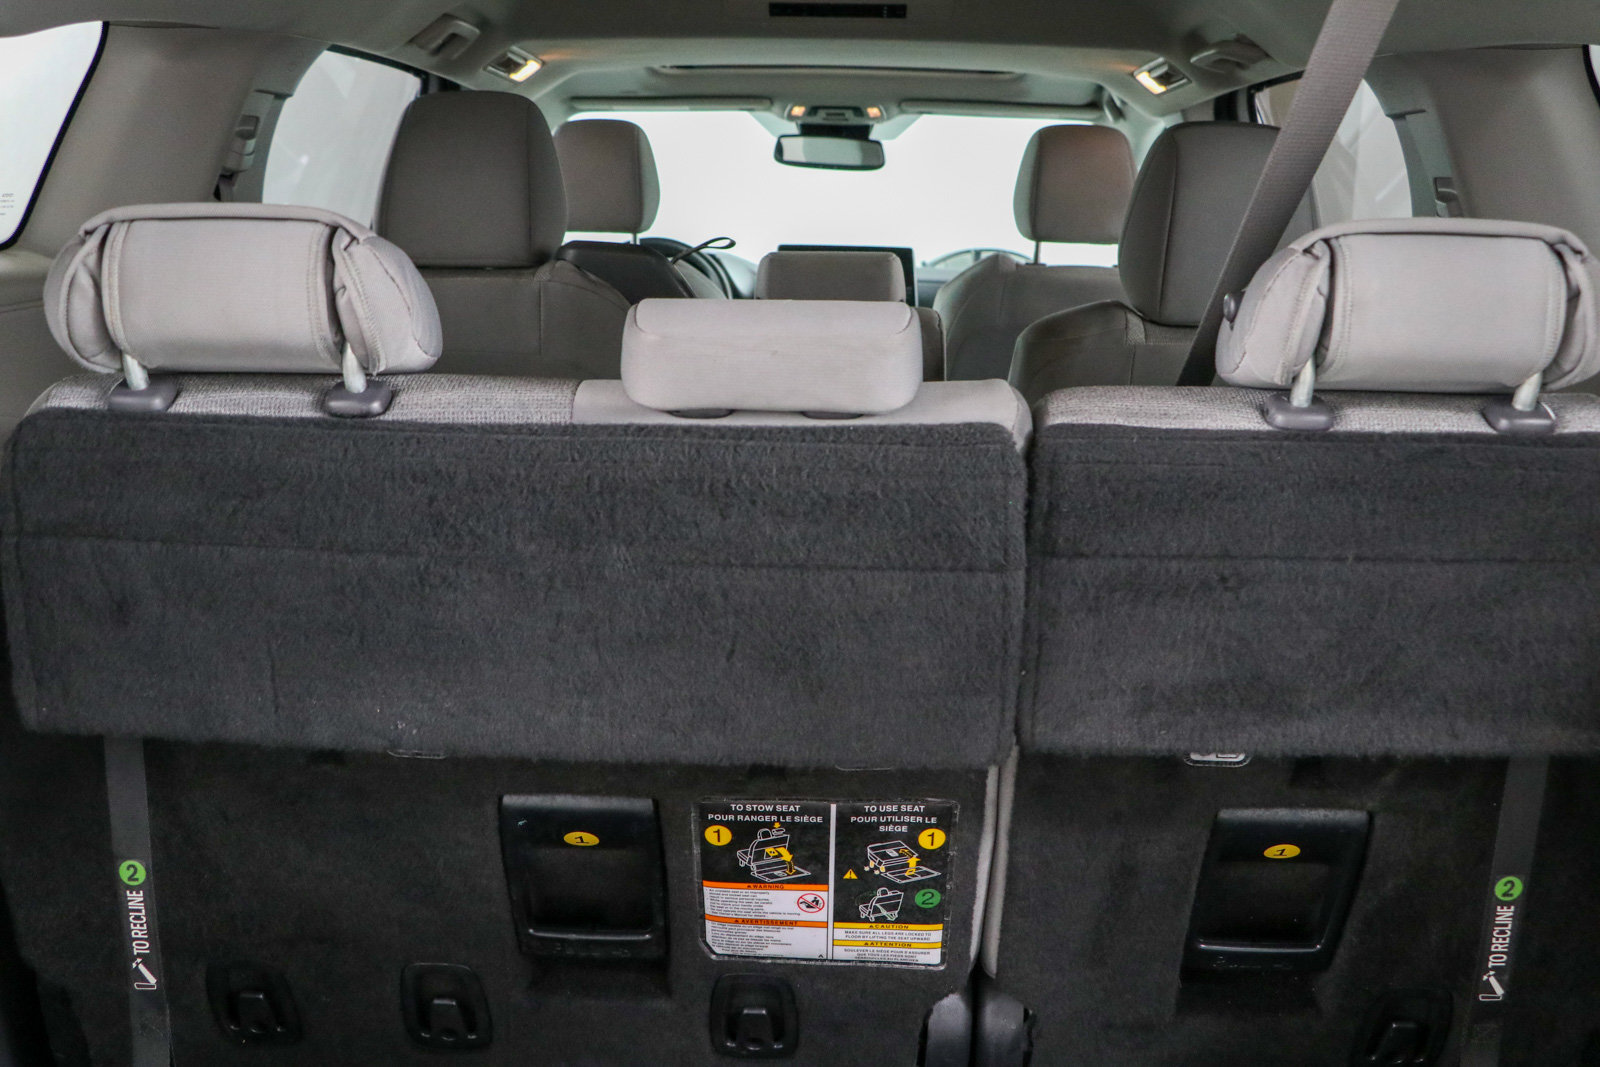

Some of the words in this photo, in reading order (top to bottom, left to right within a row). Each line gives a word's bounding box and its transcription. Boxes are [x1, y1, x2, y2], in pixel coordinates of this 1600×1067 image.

[745, 804, 774, 812] STOW
[776, 804, 801, 812] SEAT
[864, 805, 877, 813] TO
[900, 805, 925, 813] SEAT
[708, 813, 735, 821] POUR
[737, 814, 778, 822] RANGER
[794, 814, 823, 823] SIÈGE
[879, 815, 923, 823] UTILISER
[713, 828, 721, 842] 1
[879, 824, 908, 833] SIÈGE
[574, 835, 590, 844] 1
[927, 832, 935, 846] 1
[1273, 848, 1287, 857] 1
[126, 864, 139, 882] 2
[1501, 880, 1515, 898] 2
[922, 891, 934, 905] 2
[126, 890, 149, 939] RECLINE
[1490, 905, 1515, 952] RECLINE
[132, 940, 151, 956] TO
[1488, 953, 1507, 969] TO
